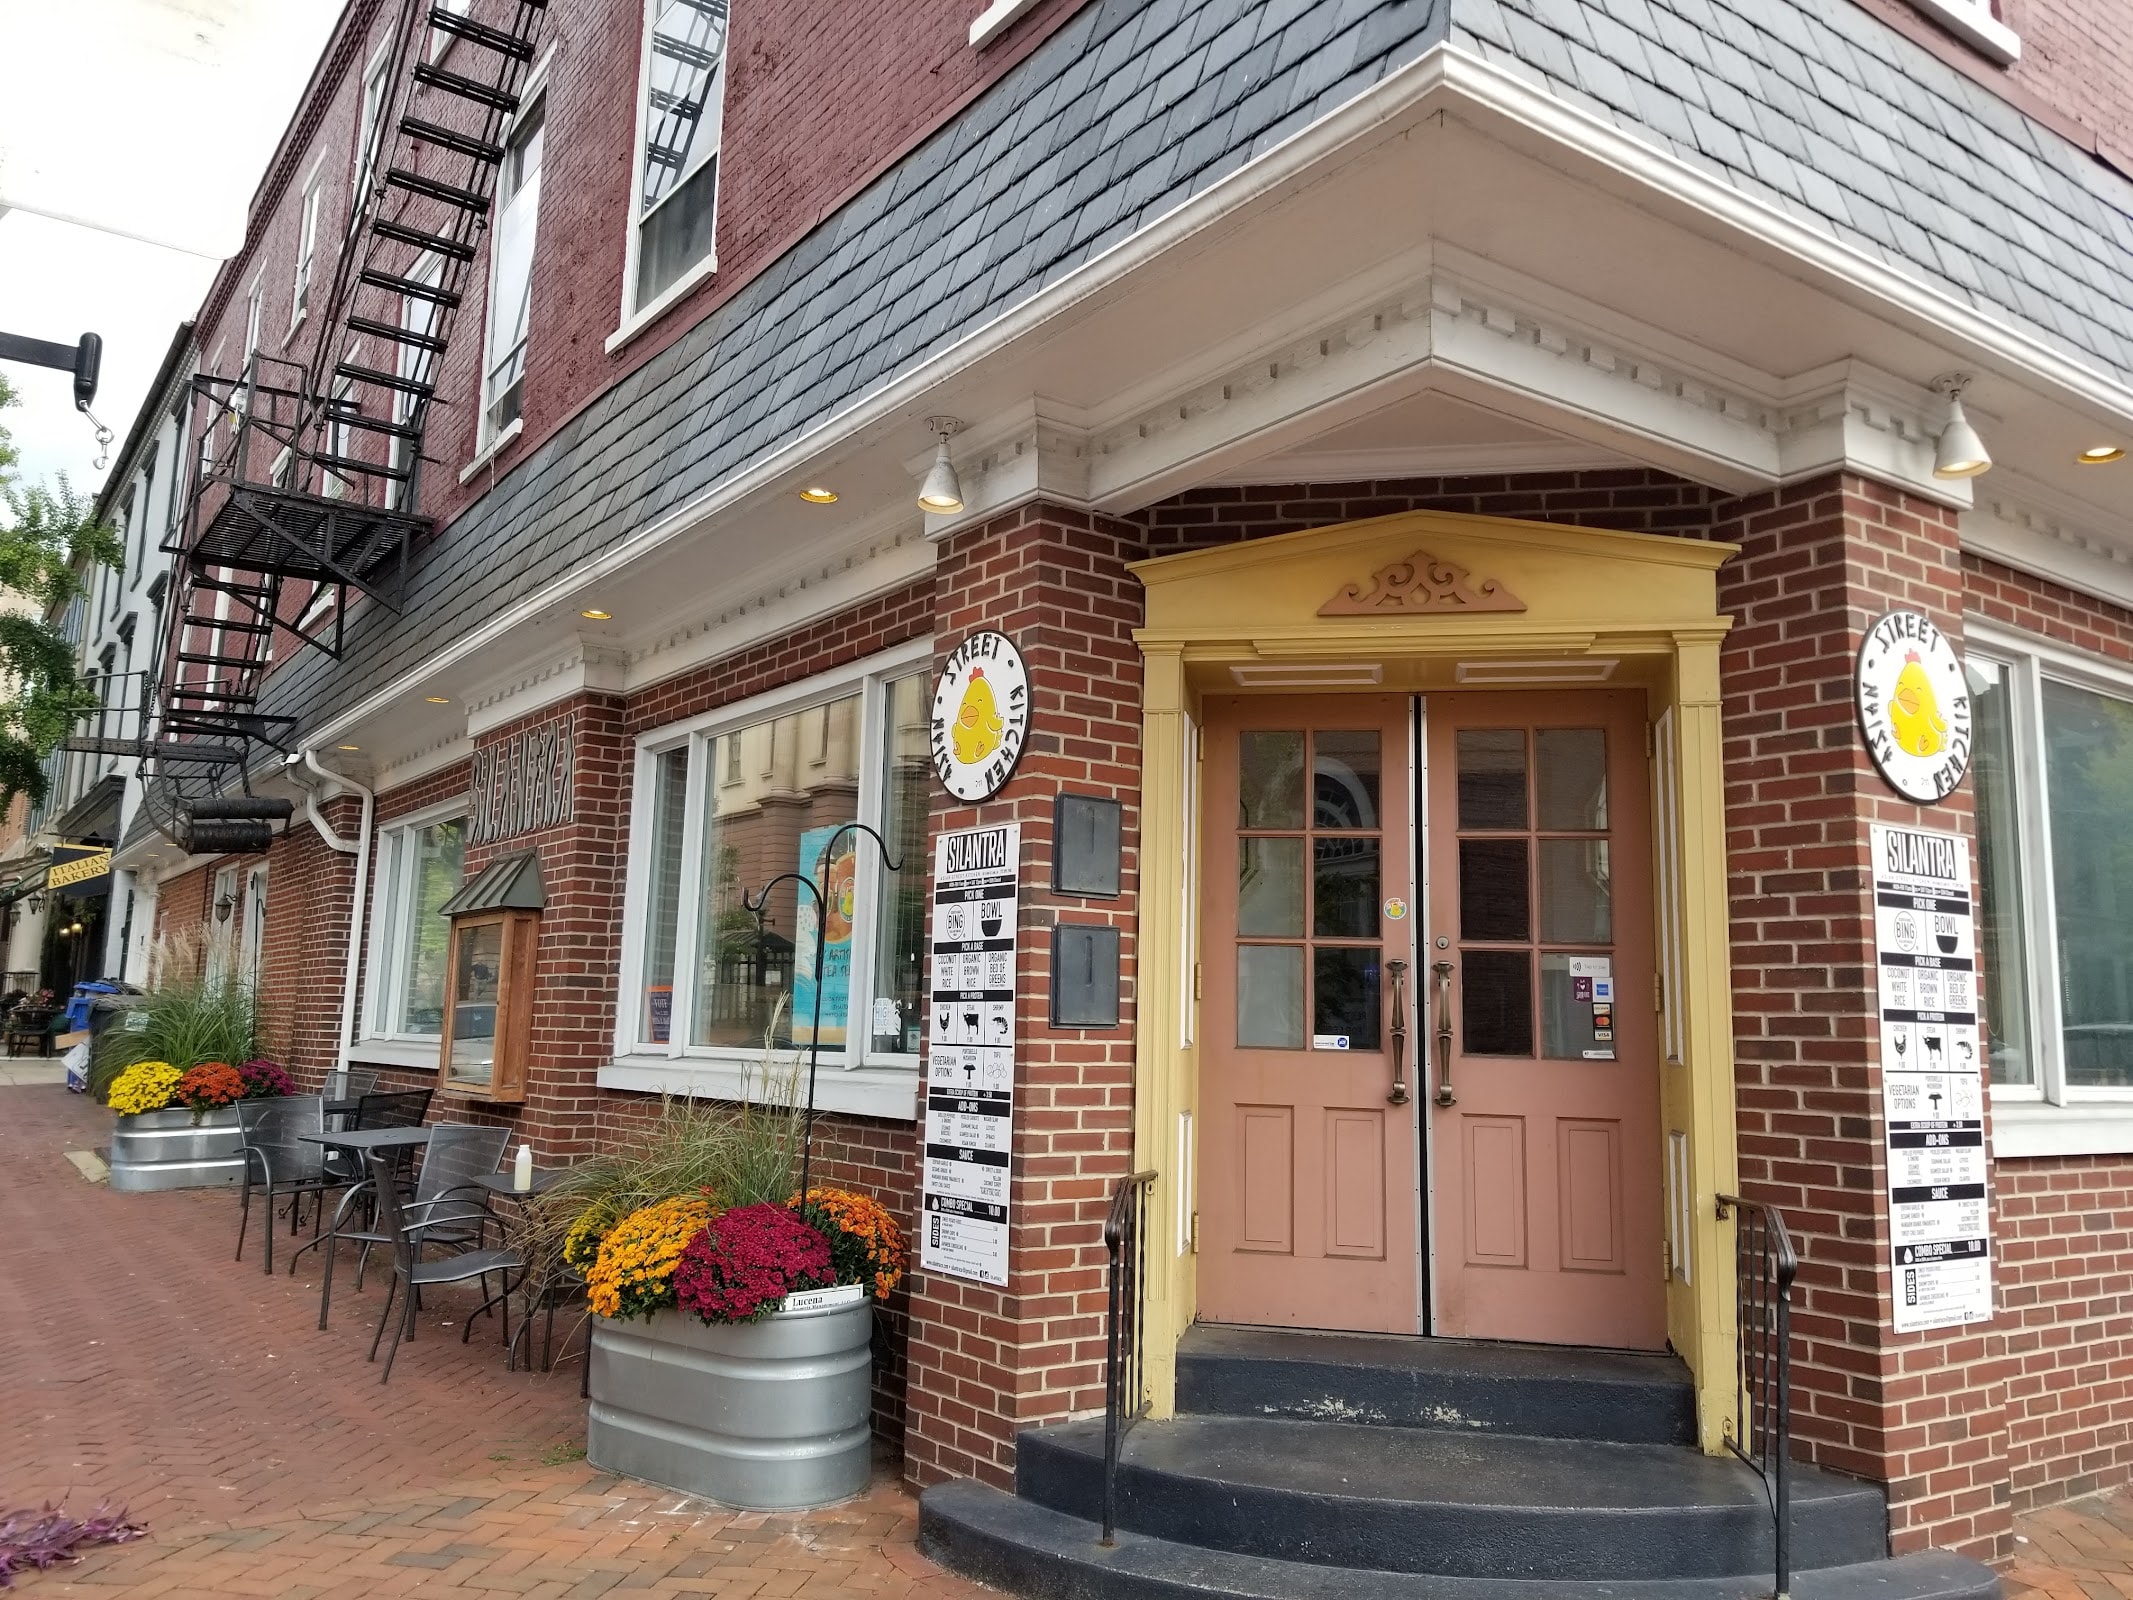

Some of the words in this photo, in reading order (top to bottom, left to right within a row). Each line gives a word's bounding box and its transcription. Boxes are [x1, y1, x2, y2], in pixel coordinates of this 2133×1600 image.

[1875, 614, 1939, 654] STREET
[945, 634, 1001, 685] STREET
[1863, 682, 1892, 765] ASIAN
[985, 685, 1024, 793] KITCHEN
[932, 717, 952, 783] ASIAN
[1933, 696, 1969, 798] KITCHEN
[947, 829, 1005, 873] SILANTRA
[1887, 831, 1956, 879] SILANTRA
[53, 854, 109, 876] ITALIAN
[51, 865, 107, 886] BAKERY
[964, 890, 975, 901] PICK
[975, 888, 984, 900] ONE
[1913, 897, 1926, 909] PICK
[981, 902, 1003, 918] BOWL
[948, 914, 964, 929] BING
[1934, 915, 1958, 934] BOWL
[1896, 922, 1915, 940] BING
[961, 942, 971, 952] PICK
[974, 941, 984, 951] BASE
[938, 954, 957, 964] COCONUT
[962, 953, 981, 964] ORGANIC
[988, 952, 1008, 962] ORGANIC
[1914, 956, 1926, 966] PICK
[940, 966, 954, 976] WHITE
[964, 966, 980, 976] BROWN
[990, 963, 998, 973] BED
[999, 962, 1006, 972] OF
[1887, 967, 1910, 979] COCONUT
[989, 974, 1006, 984] GREENS
[1918, 969, 1938, 981] ORGANIC
[1946, 972, 1968, 983] ORGANIC
[942, 978, 952, 988] RICE
[966, 978, 976, 988] RICE
[1892, 982, 1908, 992] WHITE
[1920, 983, 1938, 994] BROWN
[1949, 983, 1958, 994] BED
[1960, 984, 1966, 994] OF
[654, 998, 668, 1008] VOTE
[1894, 995, 1906, 1006] RICE
[1924, 996, 1936, 1008] RICE
[1949, 994, 1968, 1006] GREENS
[932, 1056, 956, 1066] VEGETARIAN
[935, 1068, 952, 1078] OPTIONS
[1888, 1084, 1920, 1096] VEGETARIAN
[958, 1100, 978, 1112] ADD-ONS
[1894, 1098, 1916, 1110] OPTIONS
[1926, 1134, 1950, 1146] ADD-ONS
[958, 1149, 974, 1160] SAUCE
[1932, 1187, 1948, 1200] SAUCE
[940, 1197, 956, 1210] COMBO
[956, 1199, 973, 1212] SPECIAL
[932, 1217, 940, 1247] SIDES
[1914, 1244, 1933, 1258] COMBO
[1933, 1242, 1953, 1256] SPECIAL
[1907, 1270, 1916, 1304] SIDES
[792, 1296, 823, 1307] Lucena
